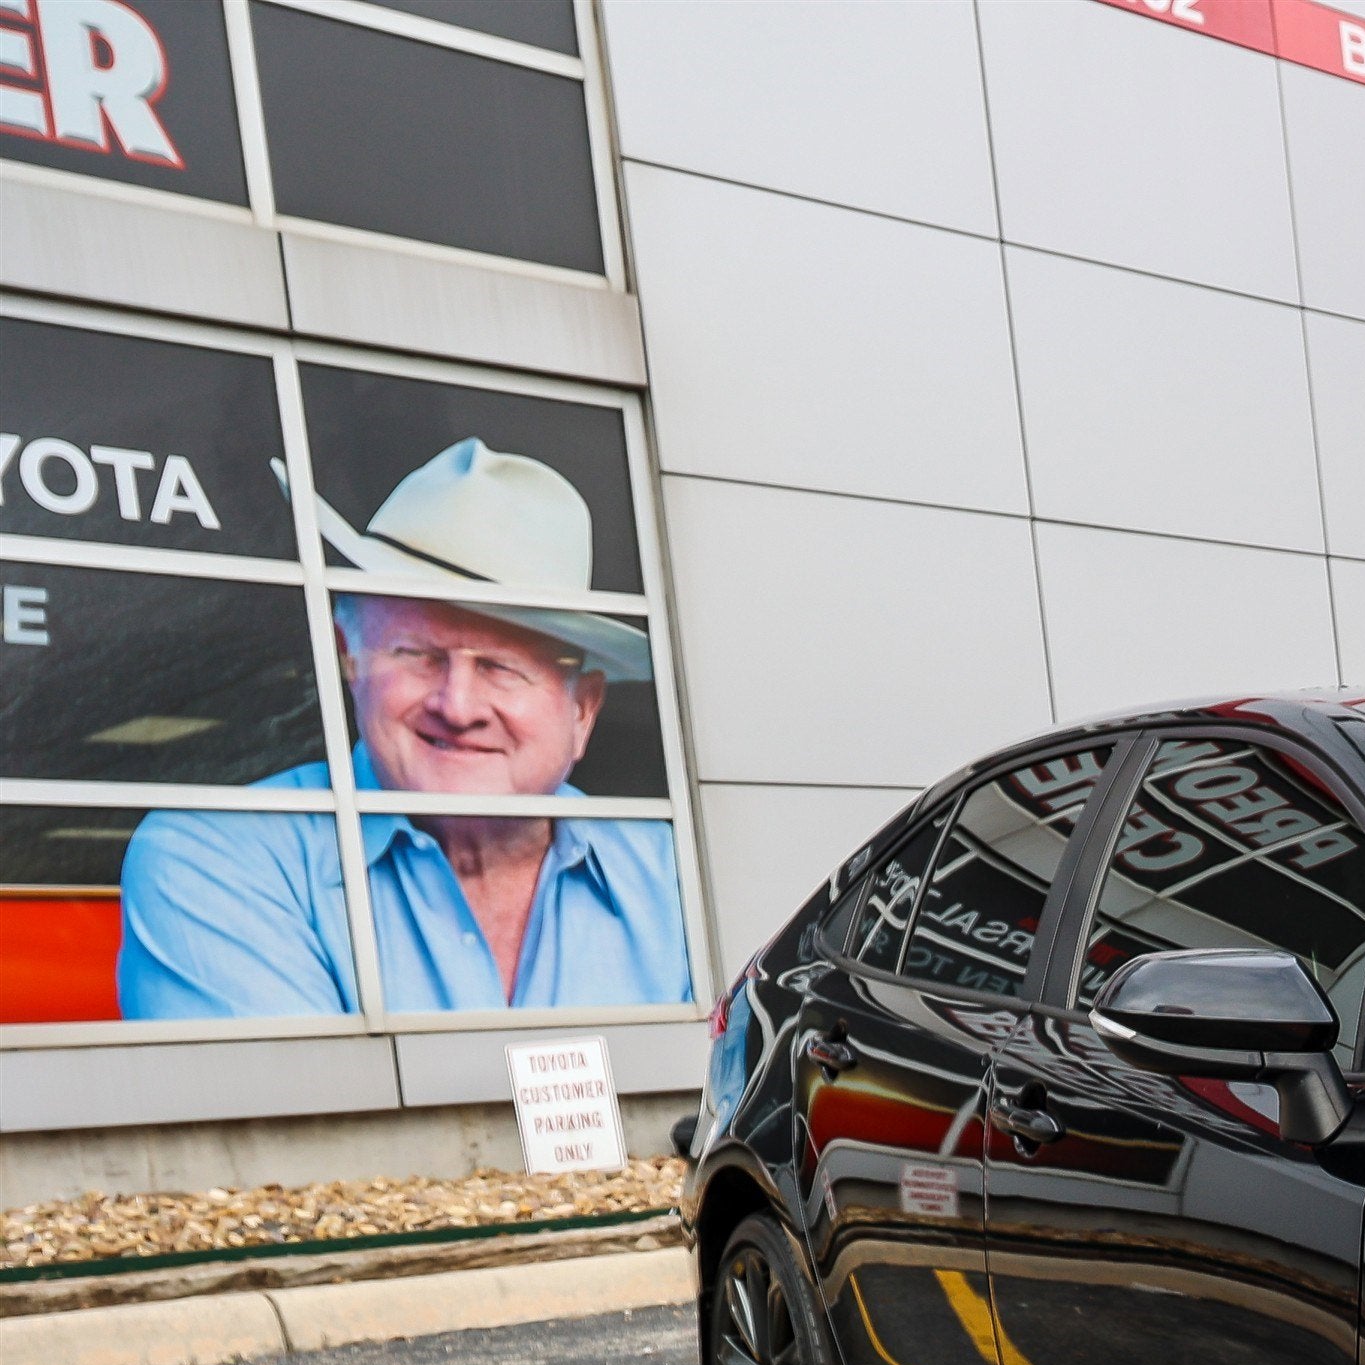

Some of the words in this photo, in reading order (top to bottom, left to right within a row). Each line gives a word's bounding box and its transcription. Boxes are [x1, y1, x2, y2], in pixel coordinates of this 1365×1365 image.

[528, 1052, 588, 1074] TOYOTA
[519, 1079, 606, 1105] CUSTOMER
[533, 1111, 605, 1135] PARKING
[553, 1142, 594, 1163] ONLY
